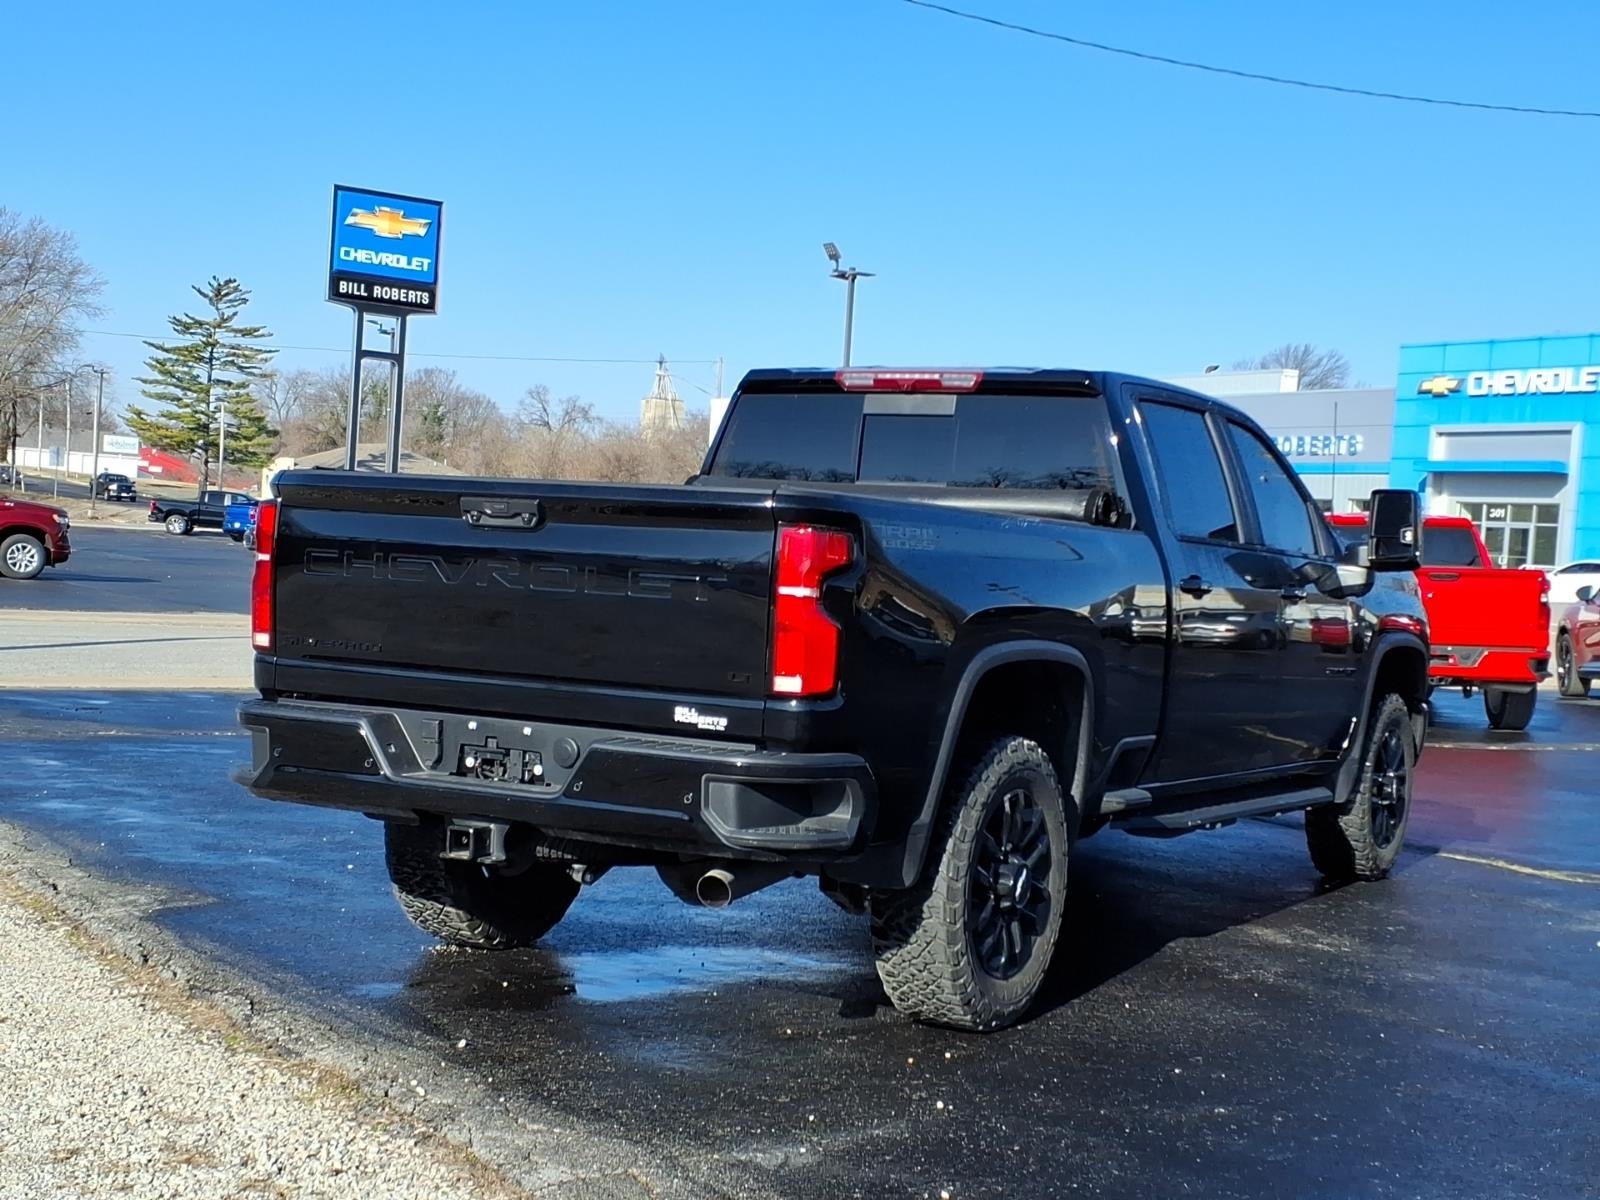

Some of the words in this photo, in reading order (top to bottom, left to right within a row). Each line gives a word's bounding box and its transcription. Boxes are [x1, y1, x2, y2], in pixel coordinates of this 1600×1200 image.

[340, 246, 431, 272] CHEVROLET
[339, 281, 368, 297] BILL
[373, 285, 429, 304] ROBERTS
[1467, 366, 1600, 397] CHEVROLE
[303, 547, 729, 601] CHEVROLET
